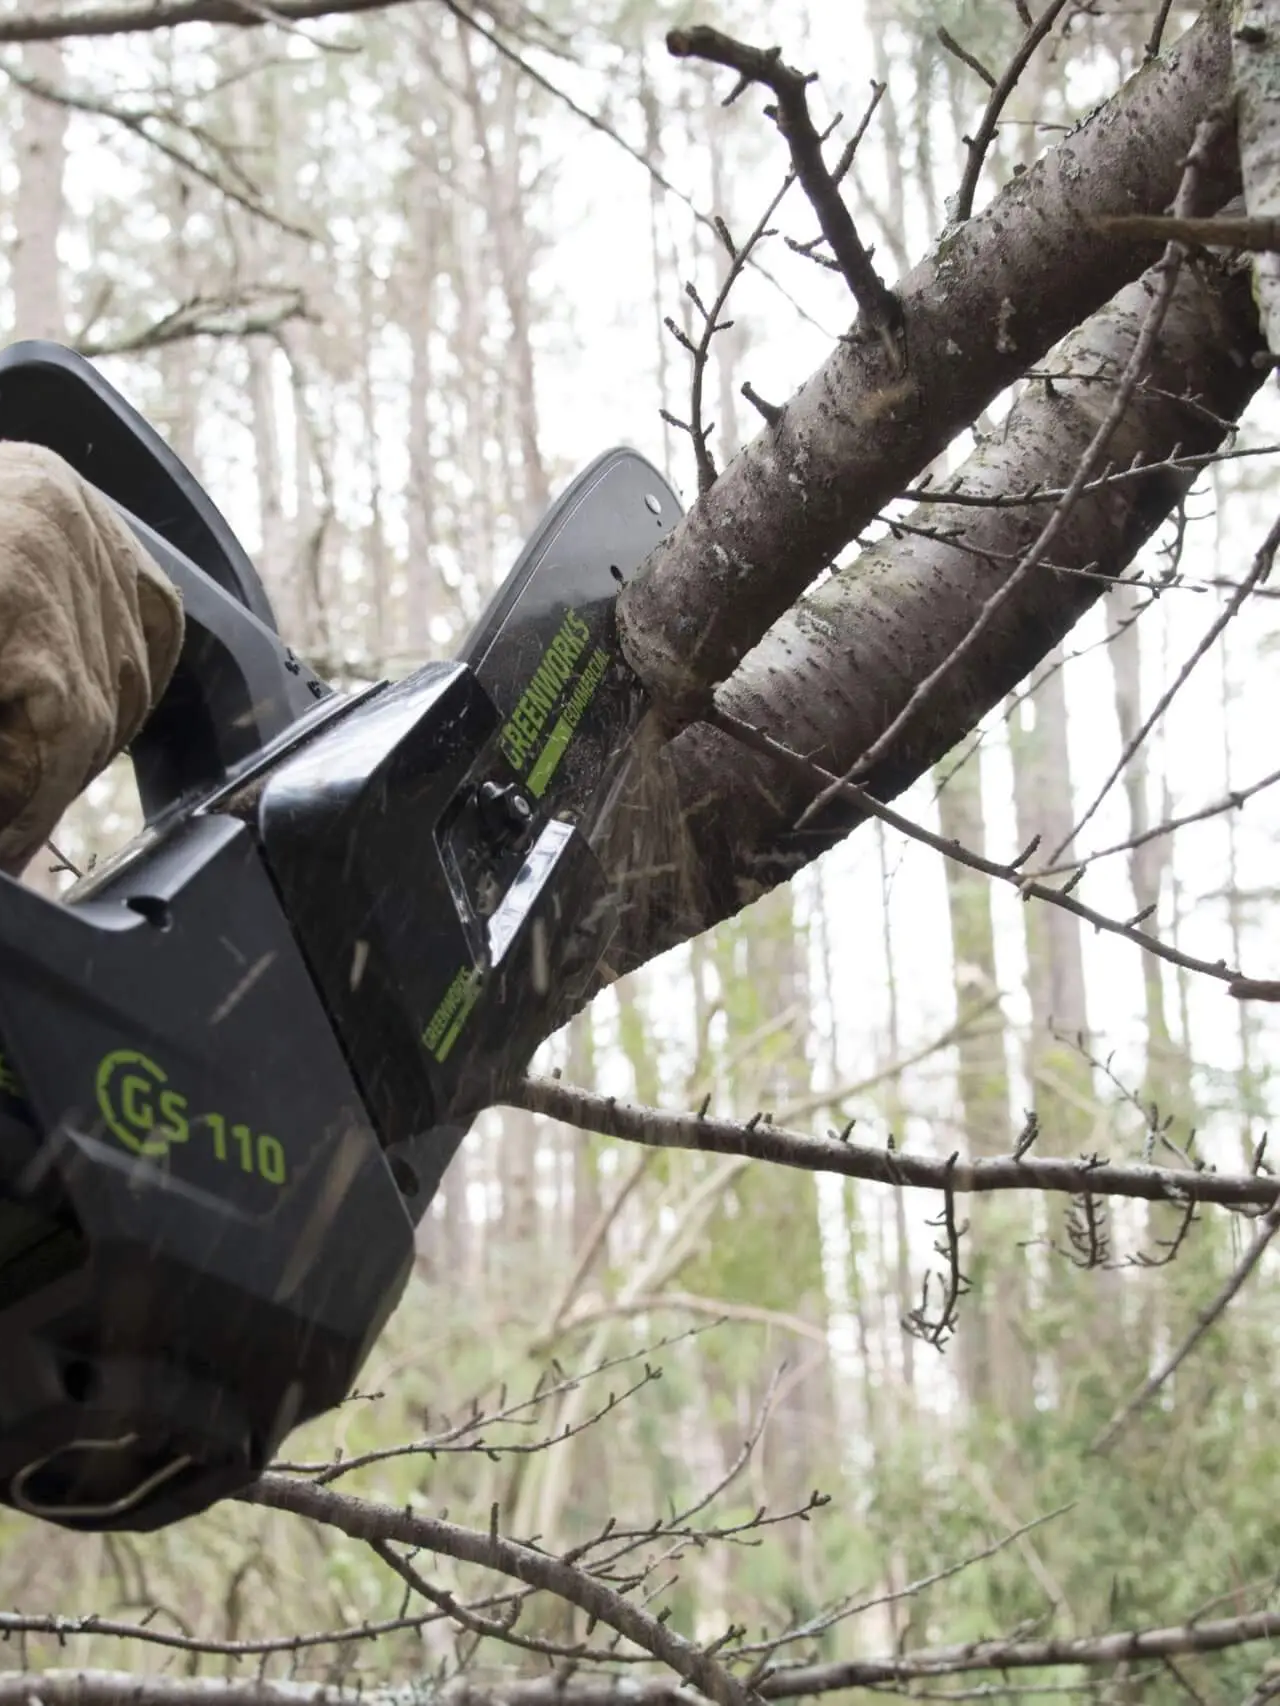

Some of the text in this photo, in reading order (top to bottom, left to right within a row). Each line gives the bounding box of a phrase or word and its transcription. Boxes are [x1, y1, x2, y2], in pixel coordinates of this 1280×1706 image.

[500, 607, 590, 770] GREENWORKS
[562, 646, 611, 729] COMMERCIAL
[206, 1112, 286, 1184] 110
